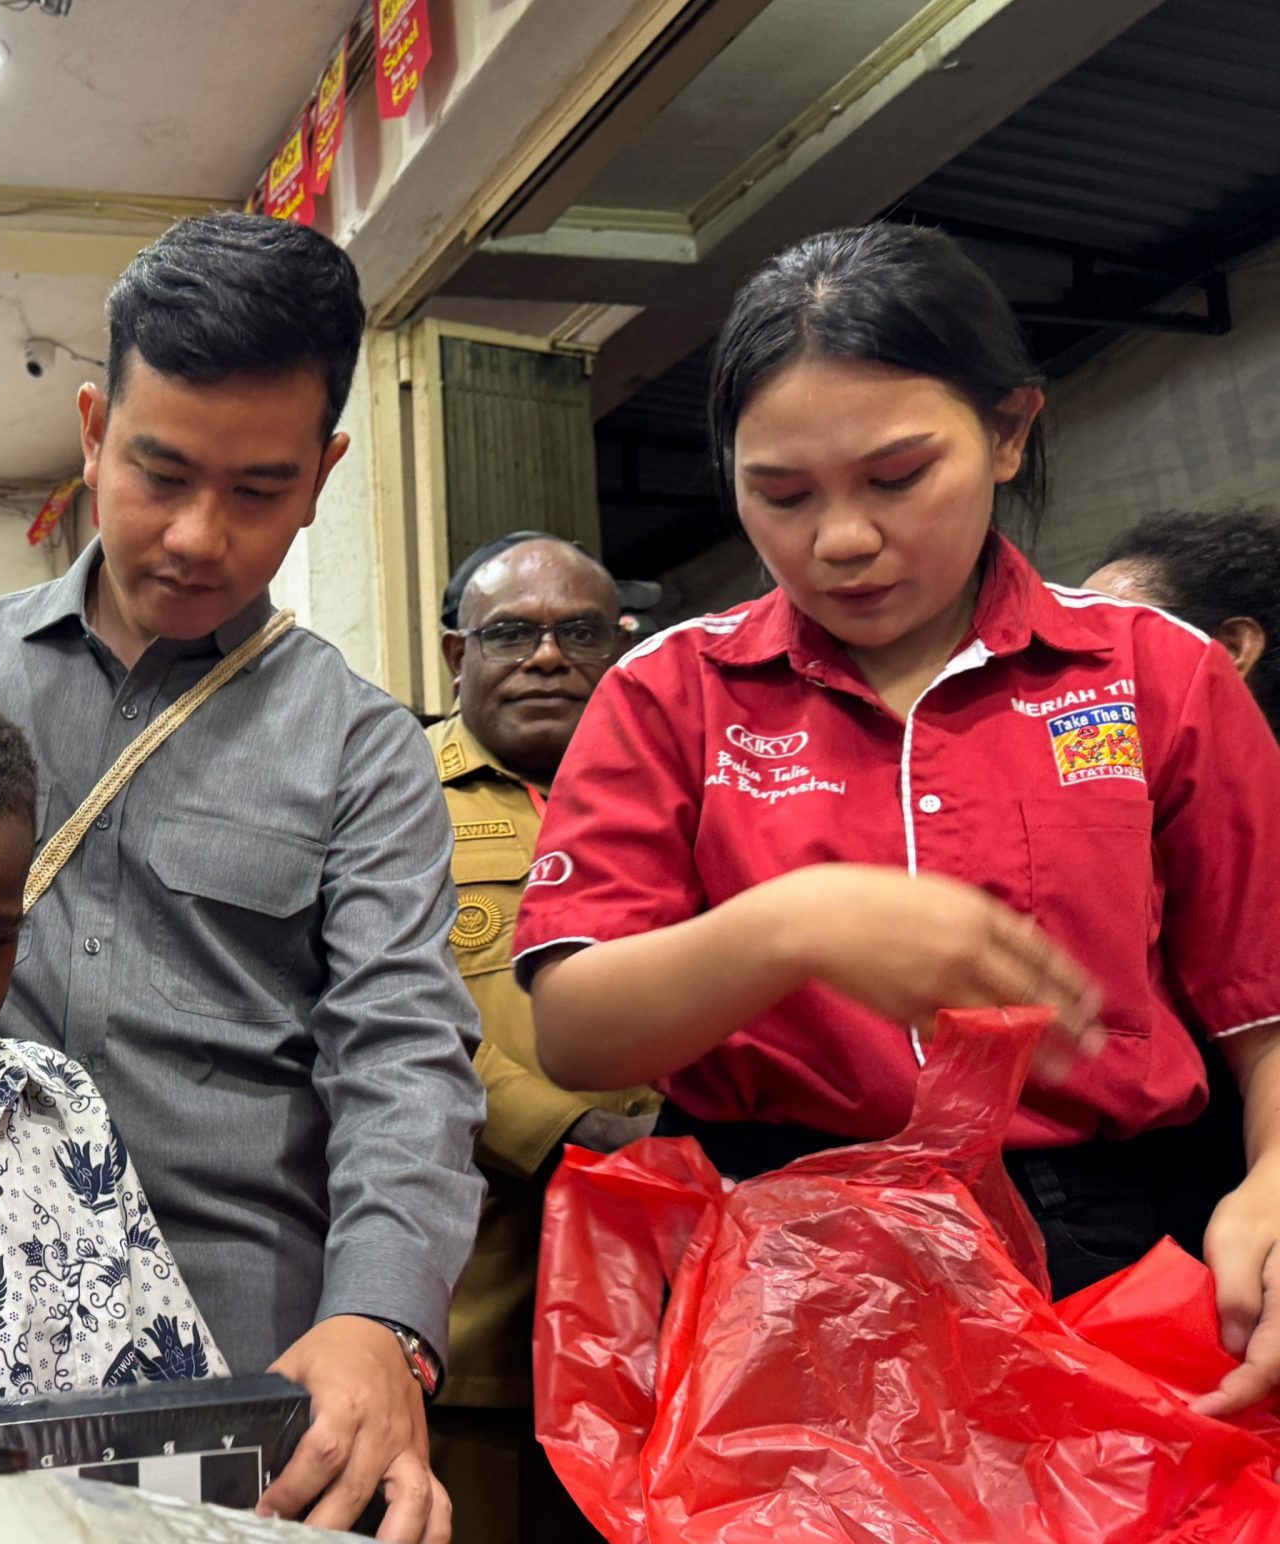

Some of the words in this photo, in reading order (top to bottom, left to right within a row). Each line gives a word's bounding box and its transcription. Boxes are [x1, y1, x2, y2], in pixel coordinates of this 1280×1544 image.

[1054, 714, 1089, 733] Take
[1090, 708, 1119, 723] The
[739, 732, 794, 755] KIKY
[716, 750, 762, 782] Buku
[768, 764, 811, 783] Tulis
[737, 775, 846, 804] Berprestasi
